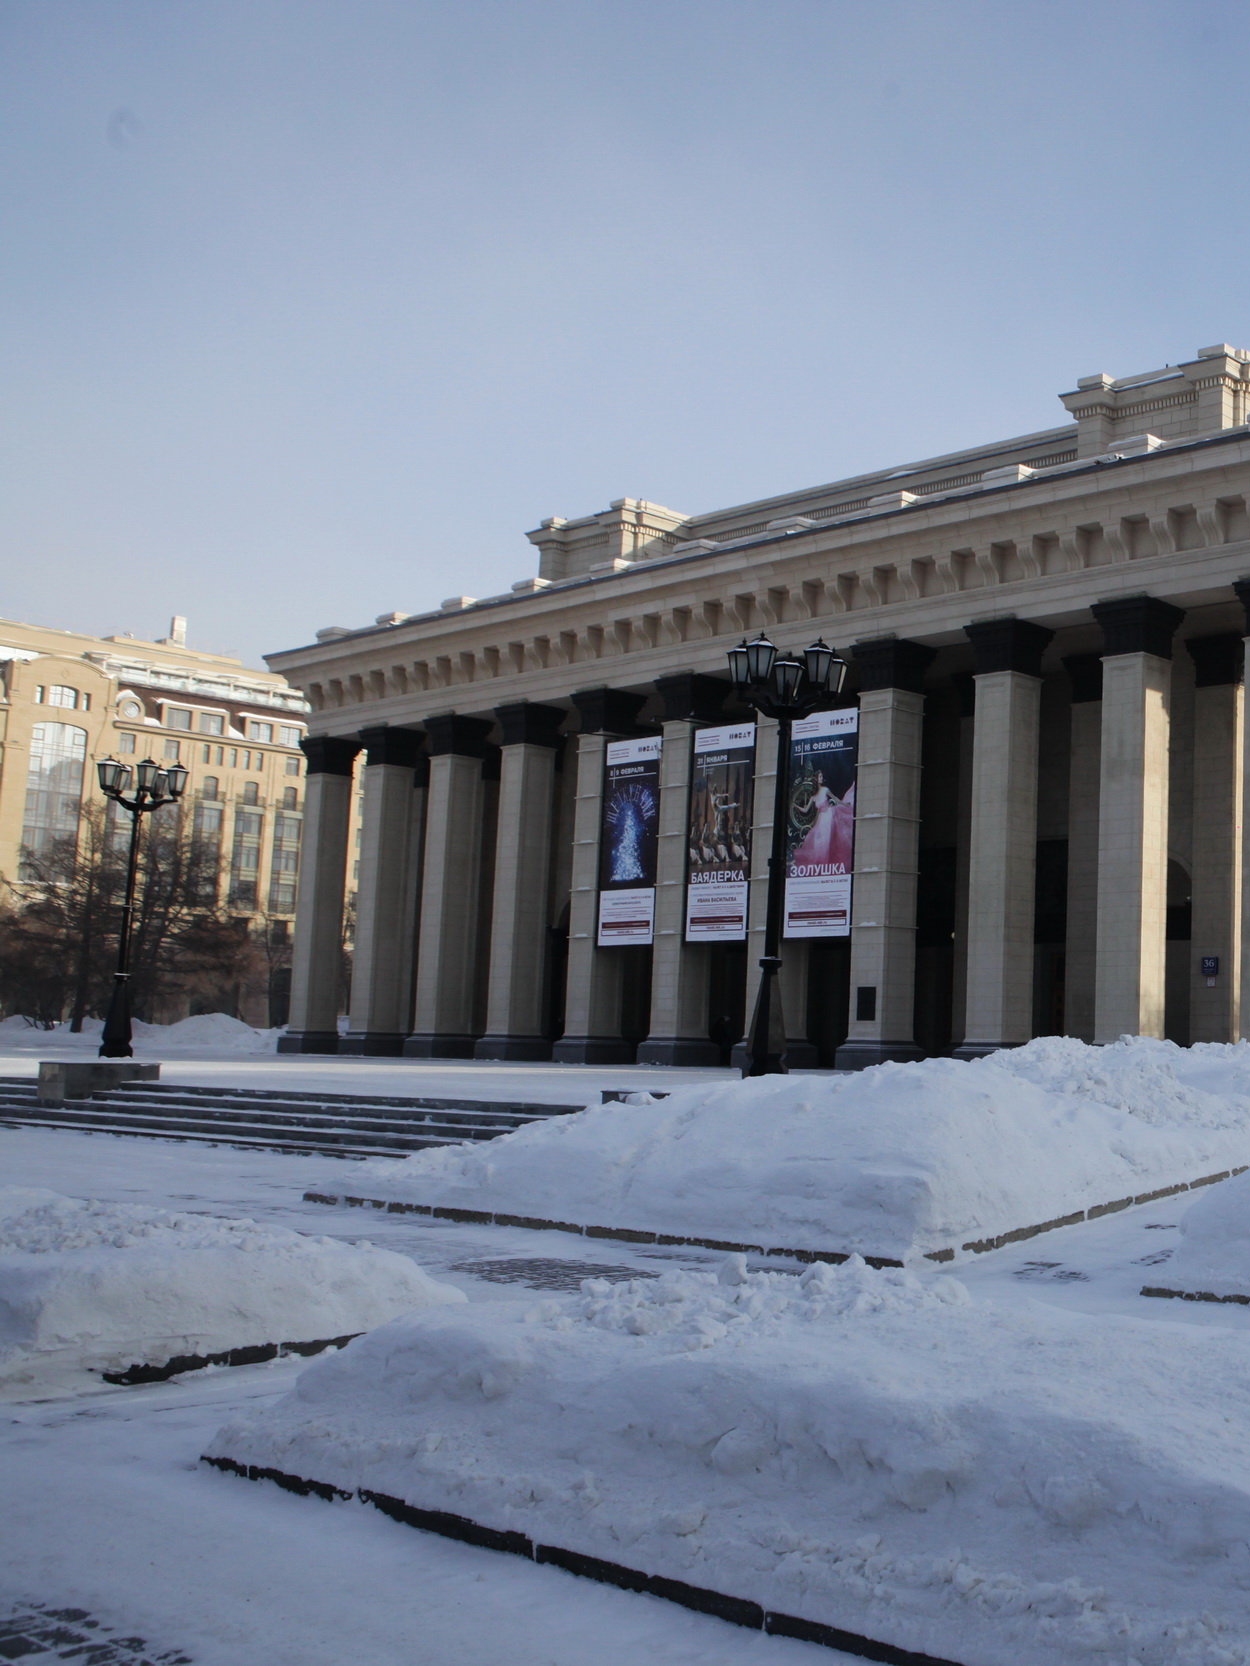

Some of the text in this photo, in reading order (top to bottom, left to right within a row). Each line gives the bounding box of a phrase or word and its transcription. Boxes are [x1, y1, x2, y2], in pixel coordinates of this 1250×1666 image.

[812, 740, 844, 750] ФЕВРАЛЯ
[706, 755, 728, 763] ЯНВАРЯ
[620, 766, 644, 775] ФЕВРАЛЯ
[790, 863, 846, 877] ЗОЛУШКА
[691, 870, 745, 884] БАЯДЕРКА
[1203, 959, 1215, 968] 36
